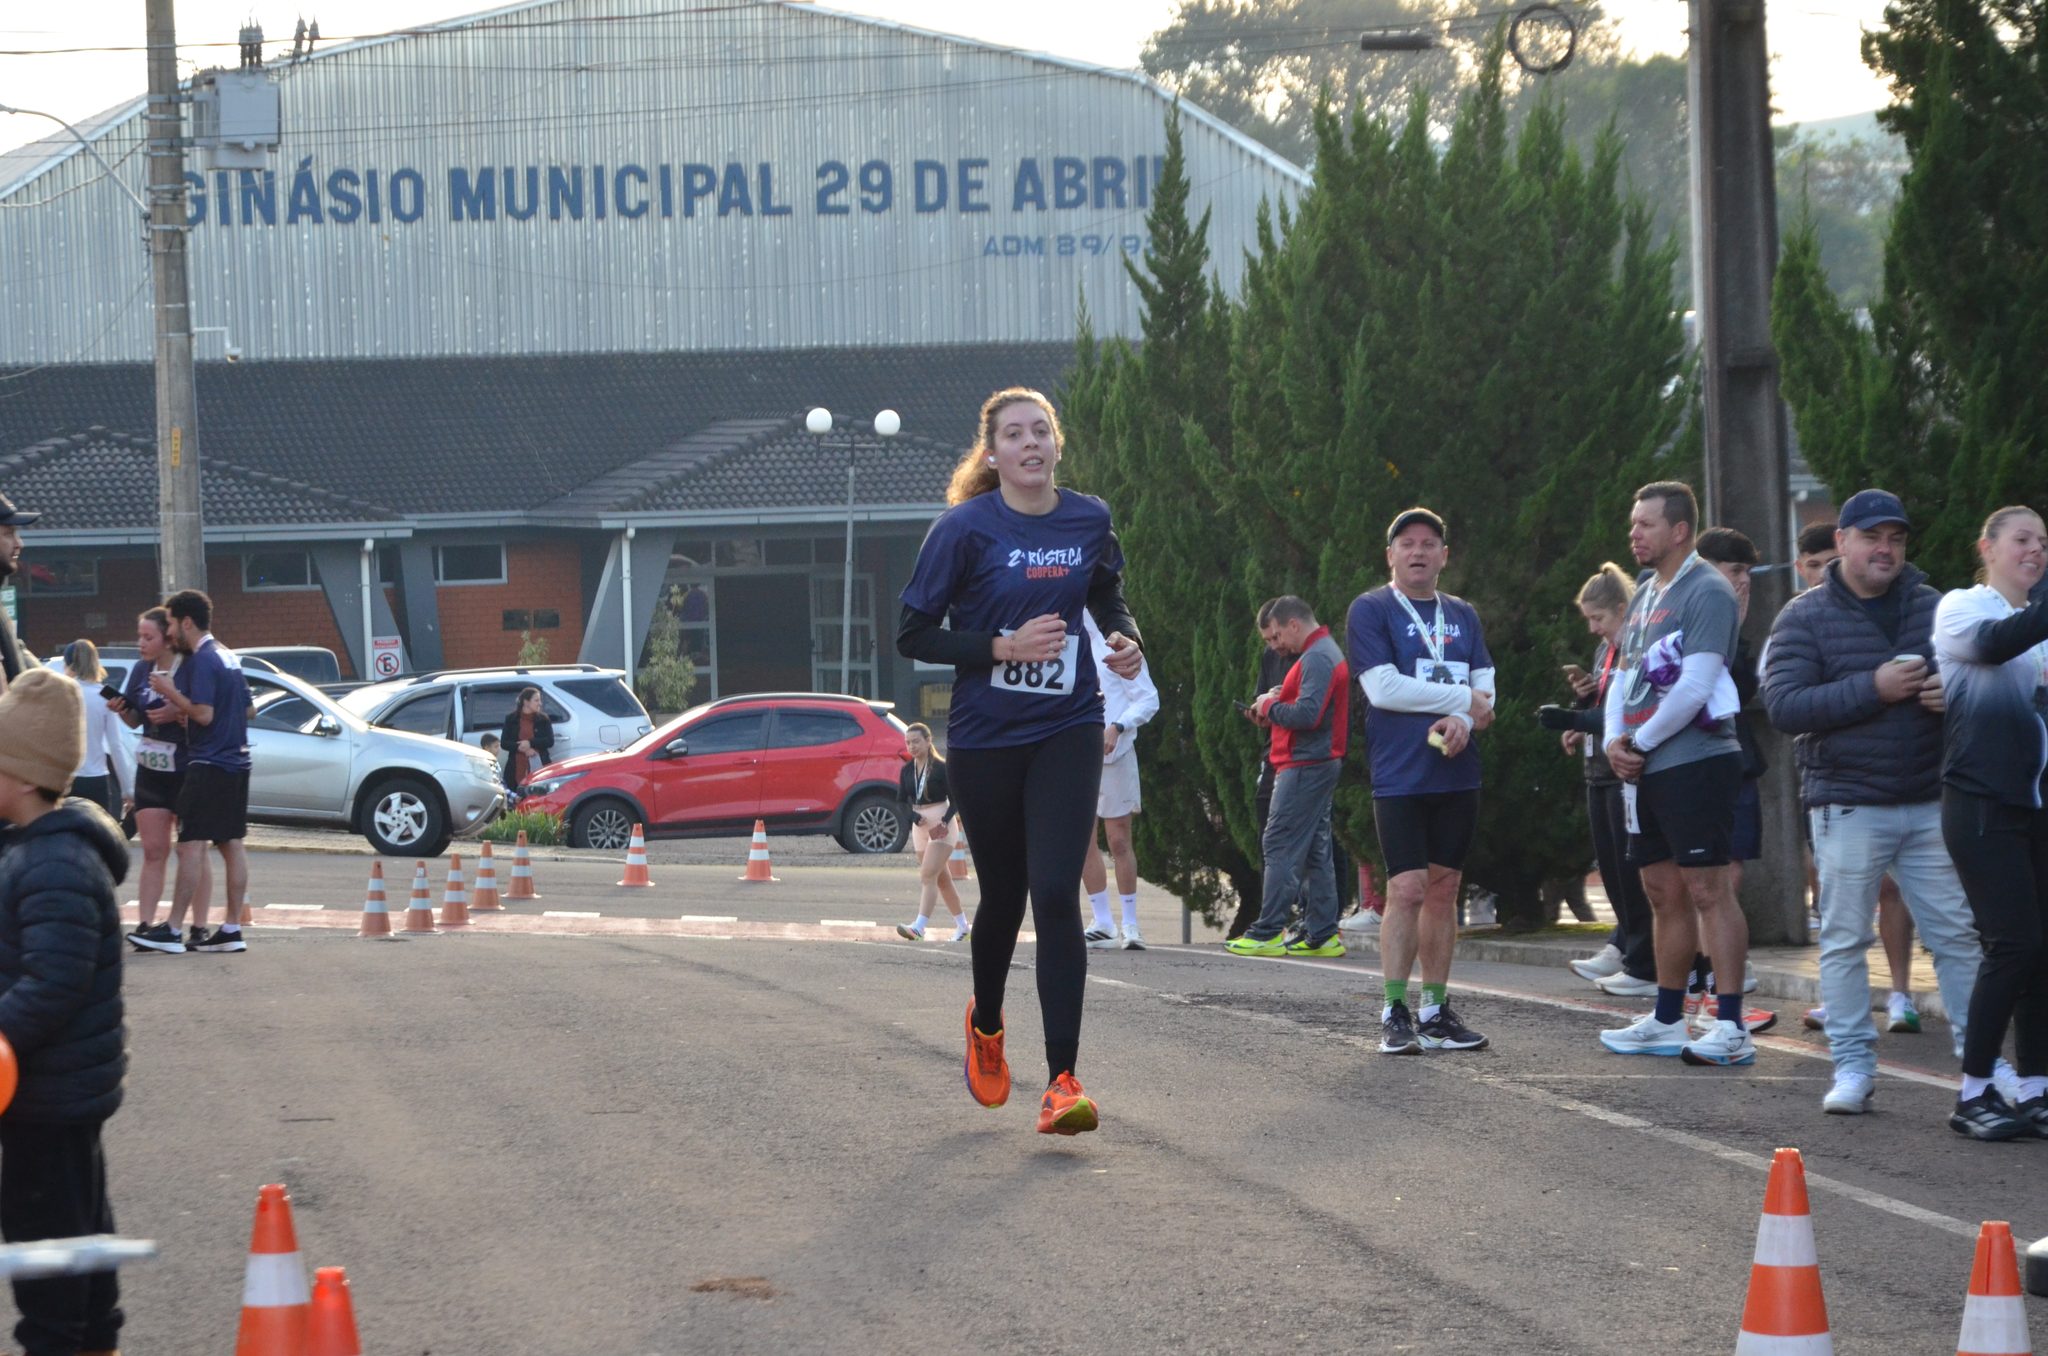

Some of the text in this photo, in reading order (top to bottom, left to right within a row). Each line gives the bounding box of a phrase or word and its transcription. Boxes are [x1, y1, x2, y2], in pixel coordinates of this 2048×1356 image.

[183, 154, 425, 227] GINÁSIO
[449, 160, 792, 223] MUNICIPAL
[816, 158, 893, 216] 29
[914, 157, 990, 214] DE
[983, 235, 1045, 257] ADM
[1028, 547, 1082, 566] RÚSTICA
[1026, 567, 1070, 579] COOPERA+
[1003, 659, 1065, 689] 882
[140, 750, 169, 769] 183
